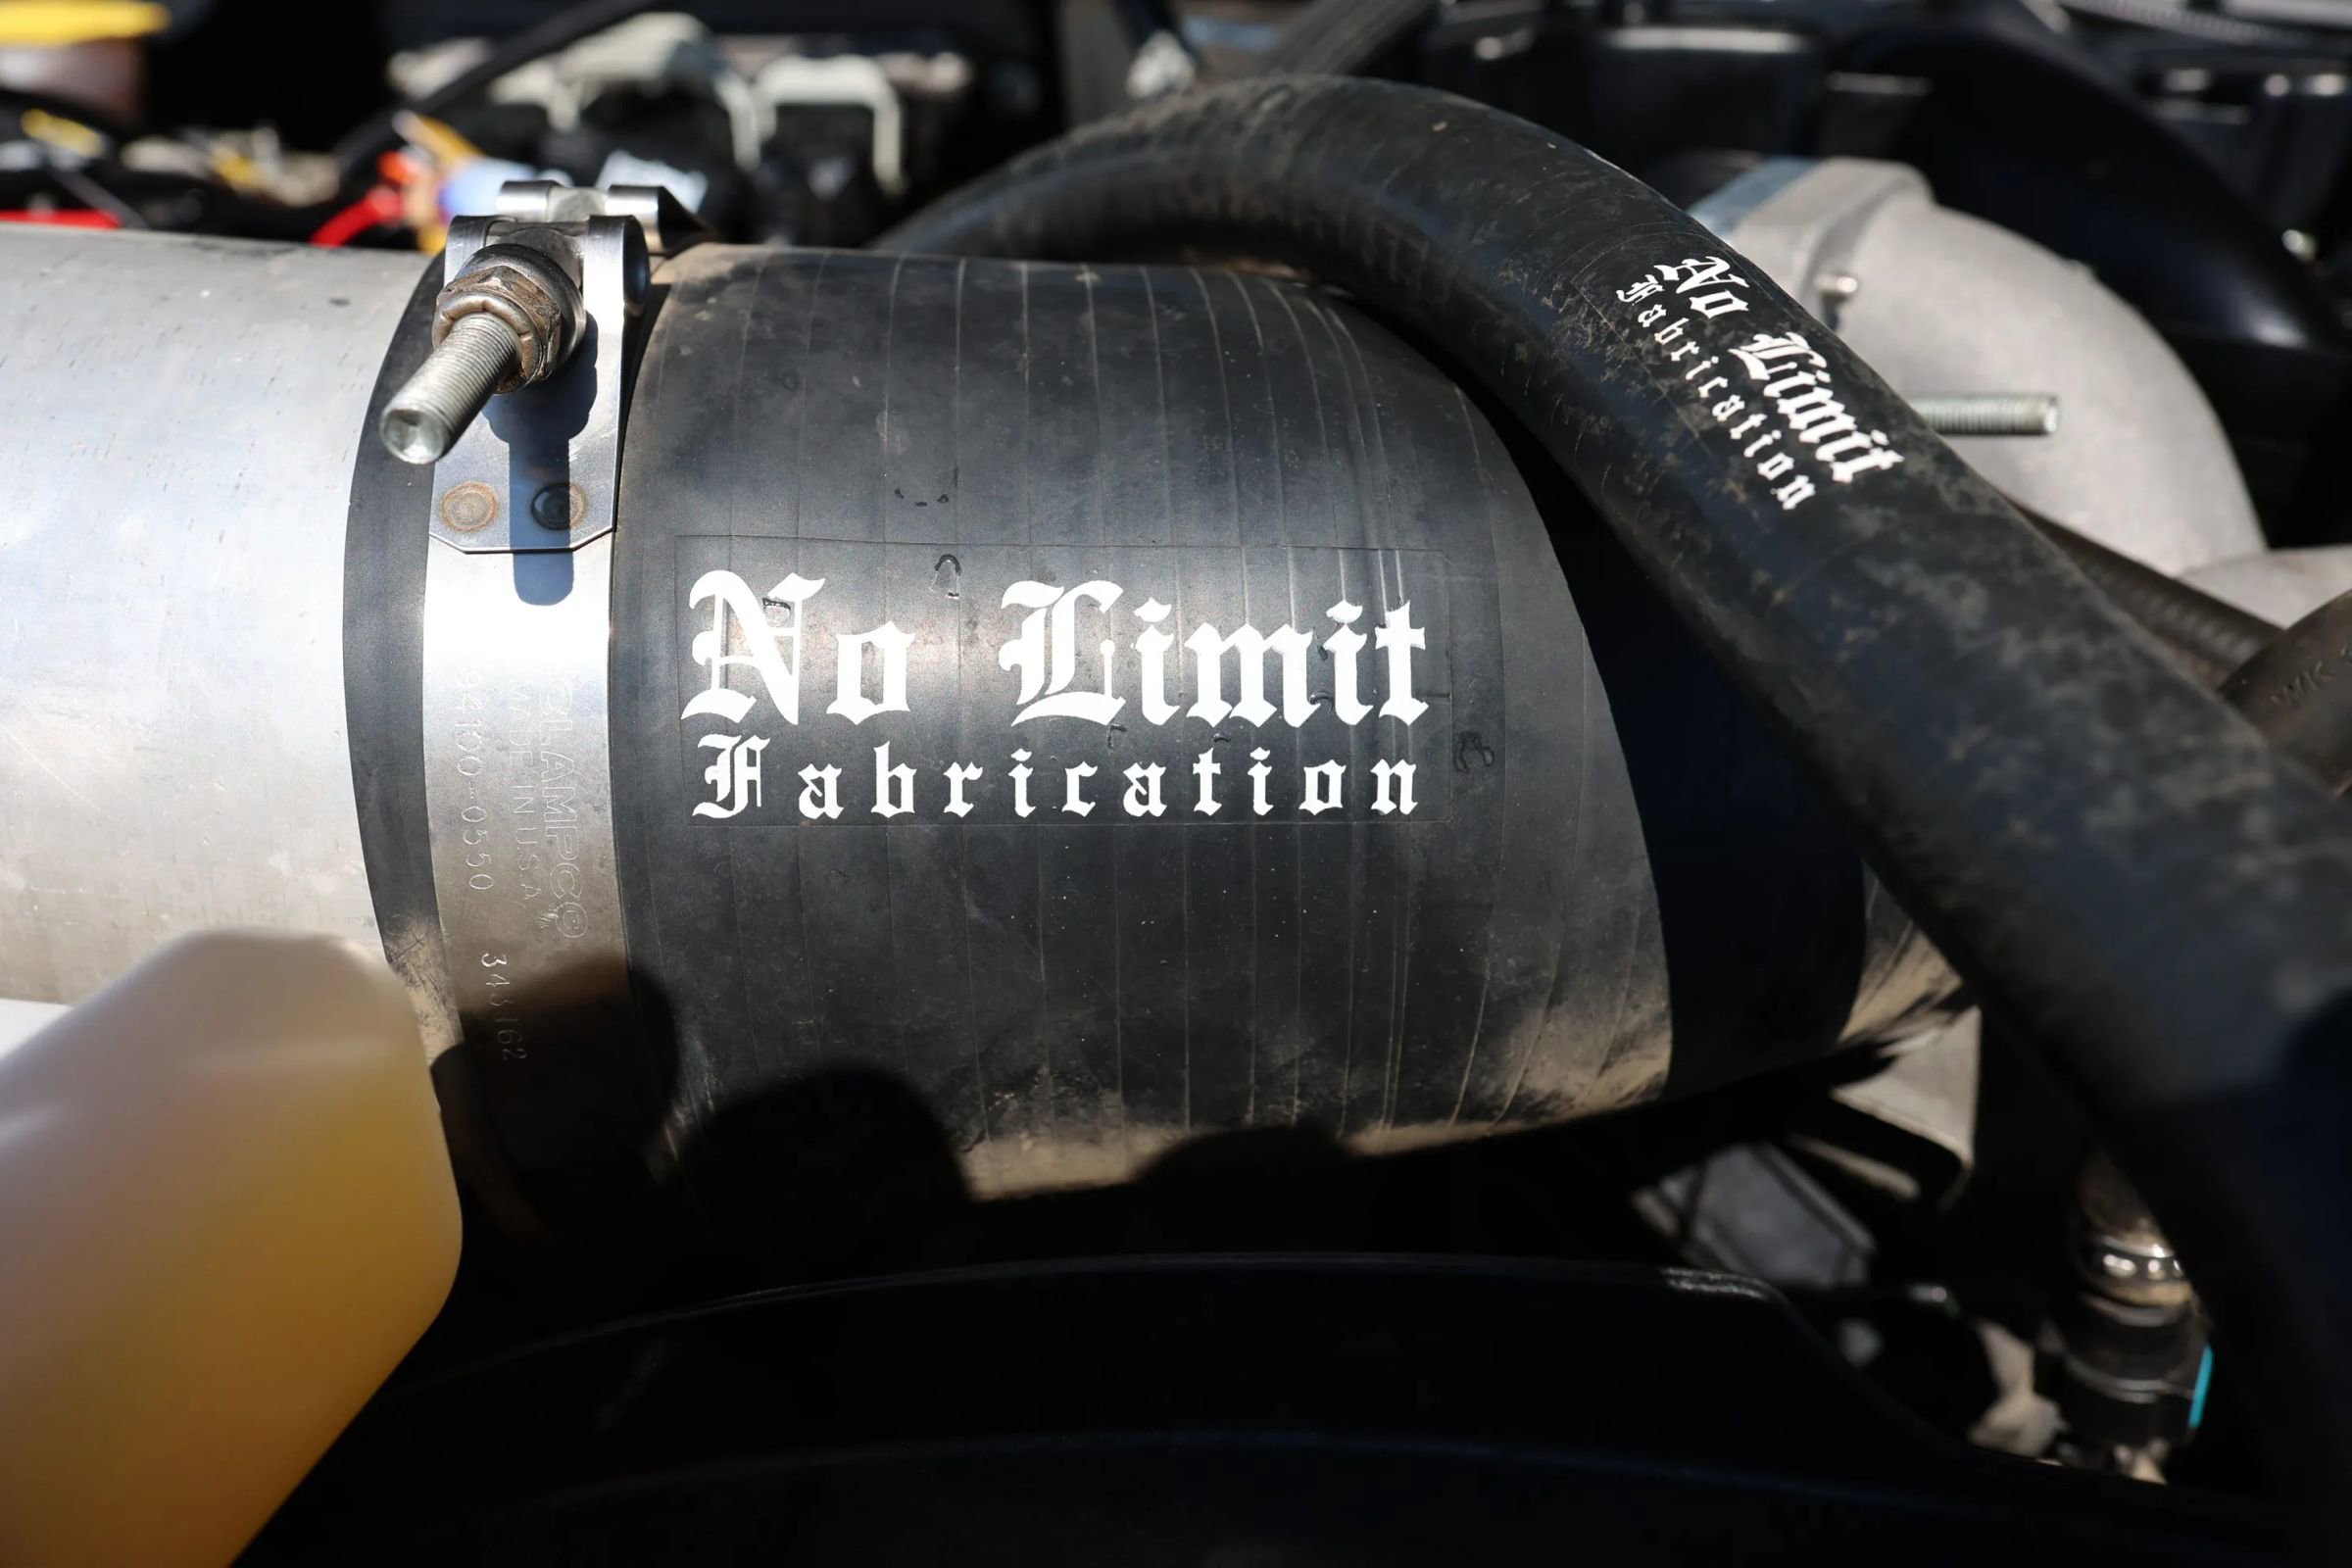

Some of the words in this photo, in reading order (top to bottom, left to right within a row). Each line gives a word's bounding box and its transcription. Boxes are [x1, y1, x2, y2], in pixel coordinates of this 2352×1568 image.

[1617, 274, 1815, 510] Fabrication
[1653, 256, 1750, 318] No
[1728, 332, 1904, 483] Limit
[681, 570, 916, 725] No
[999, 580, 1429, 727] Limit
[508, 683, 533, 767] MADE
[692, 733, 1417, 818] Fabrication
[512, 785, 535, 814] IN
